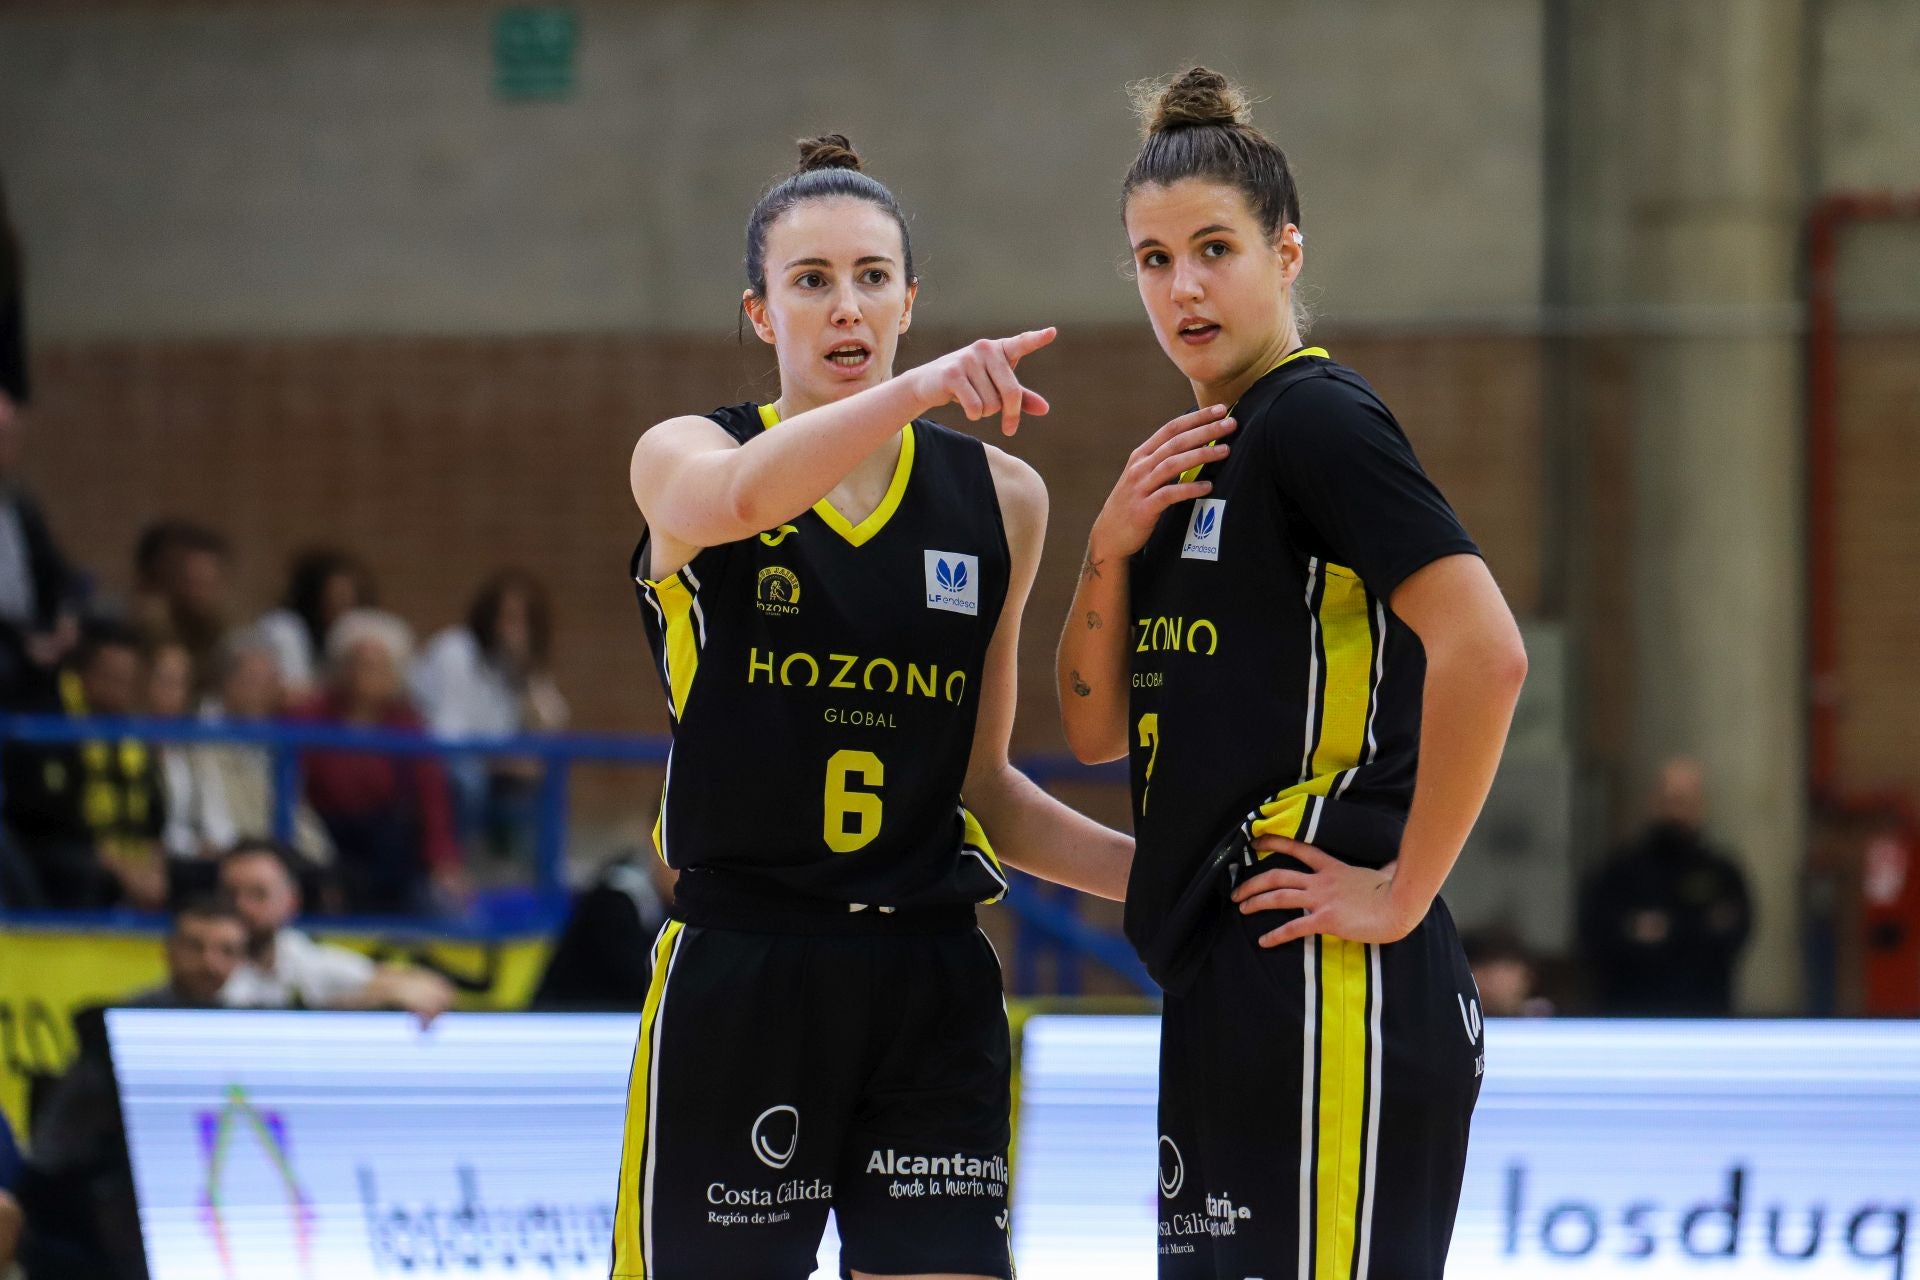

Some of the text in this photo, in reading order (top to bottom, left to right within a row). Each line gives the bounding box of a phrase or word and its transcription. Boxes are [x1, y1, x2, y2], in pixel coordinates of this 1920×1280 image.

[928, 593, 976, 609] LF endesa
[1131, 616, 1218, 656] ZONO
[748, 647, 967, 707] HOZONO
[824, 707, 898, 729] GLOBAL
[823, 749, 884, 853] 6
[706, 1178, 833, 1206] Costa Cálida
[889, 1179, 925, 1200] donde
[929, 1177, 942, 1195] la
[945, 1177, 985, 1198] huerta
[707, 1209, 790, 1227] Región de Murcia
[1170, 1242, 1195, 1255] Murcia
